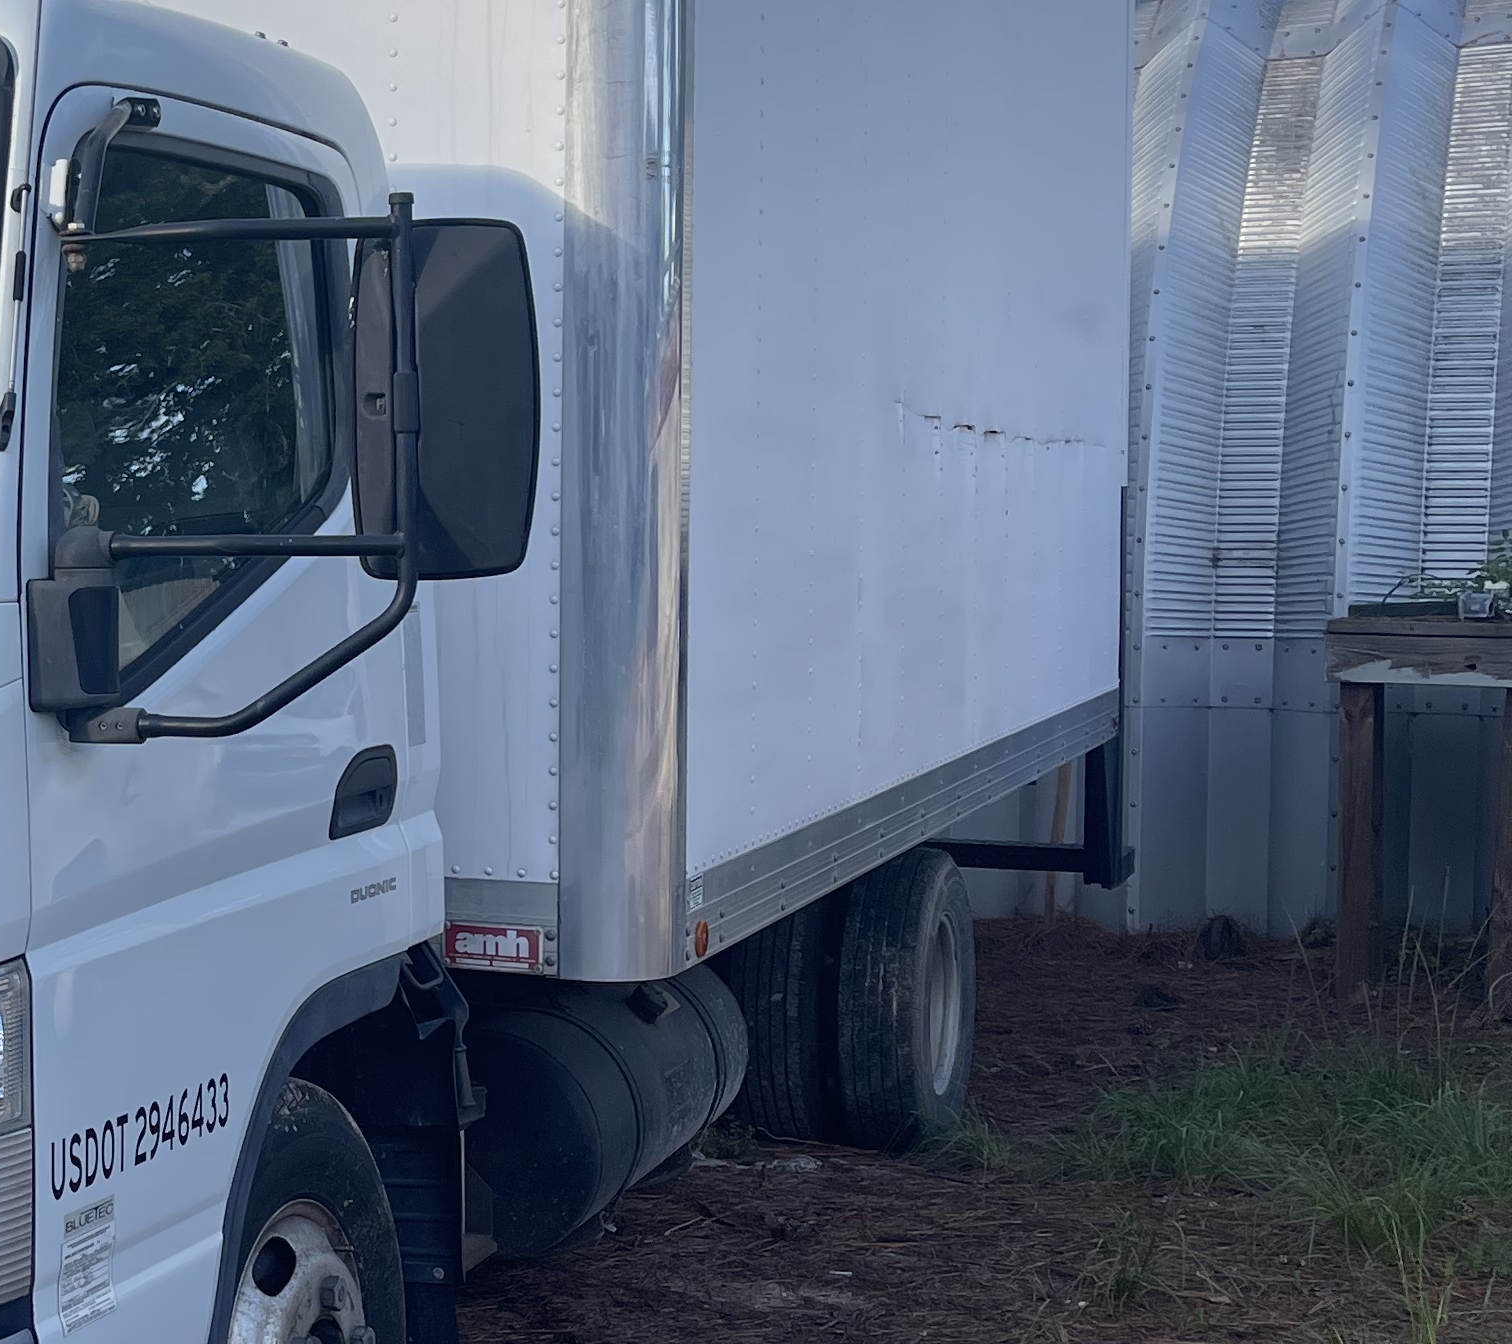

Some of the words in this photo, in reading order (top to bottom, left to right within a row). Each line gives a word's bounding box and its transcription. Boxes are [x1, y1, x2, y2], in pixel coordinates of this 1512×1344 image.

[350, 877, 397, 904] DUONIC
[454, 929, 530, 958] amh
[51, 1113, 128, 1200] USDOT
[134, 1072, 230, 1166] 2946433
[64, 1199, 115, 1234] BLUETEC
